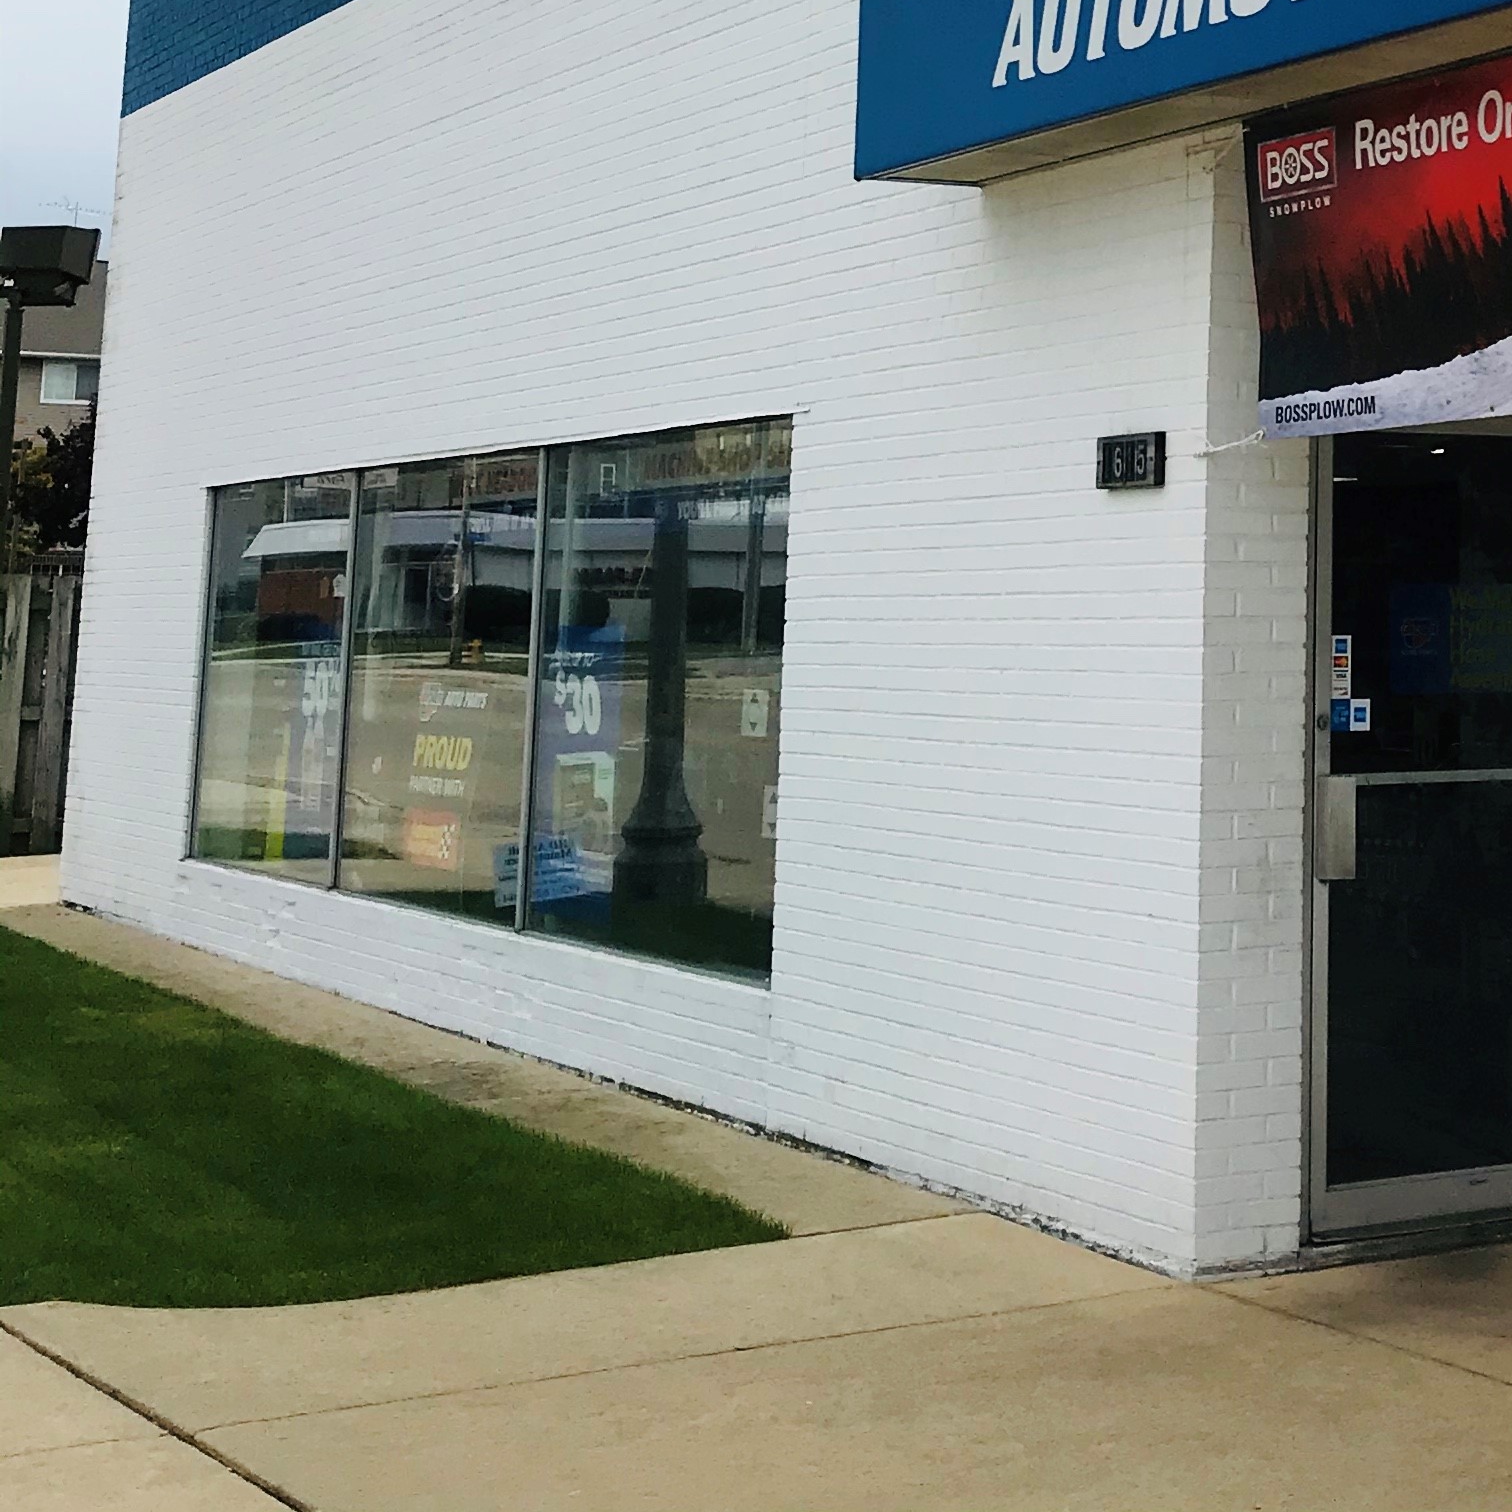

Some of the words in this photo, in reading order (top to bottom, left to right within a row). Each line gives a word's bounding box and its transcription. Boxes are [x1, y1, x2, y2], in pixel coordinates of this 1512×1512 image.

[1355, 110, 1469, 170] Restore
[1265, 138, 1330, 190] BOSS
[1269, 194, 1332, 218] SNOWPLOW
[1275, 395, 1376, 424] BOSSPLOW.COM
[413, 734, 473, 771] PROUD
